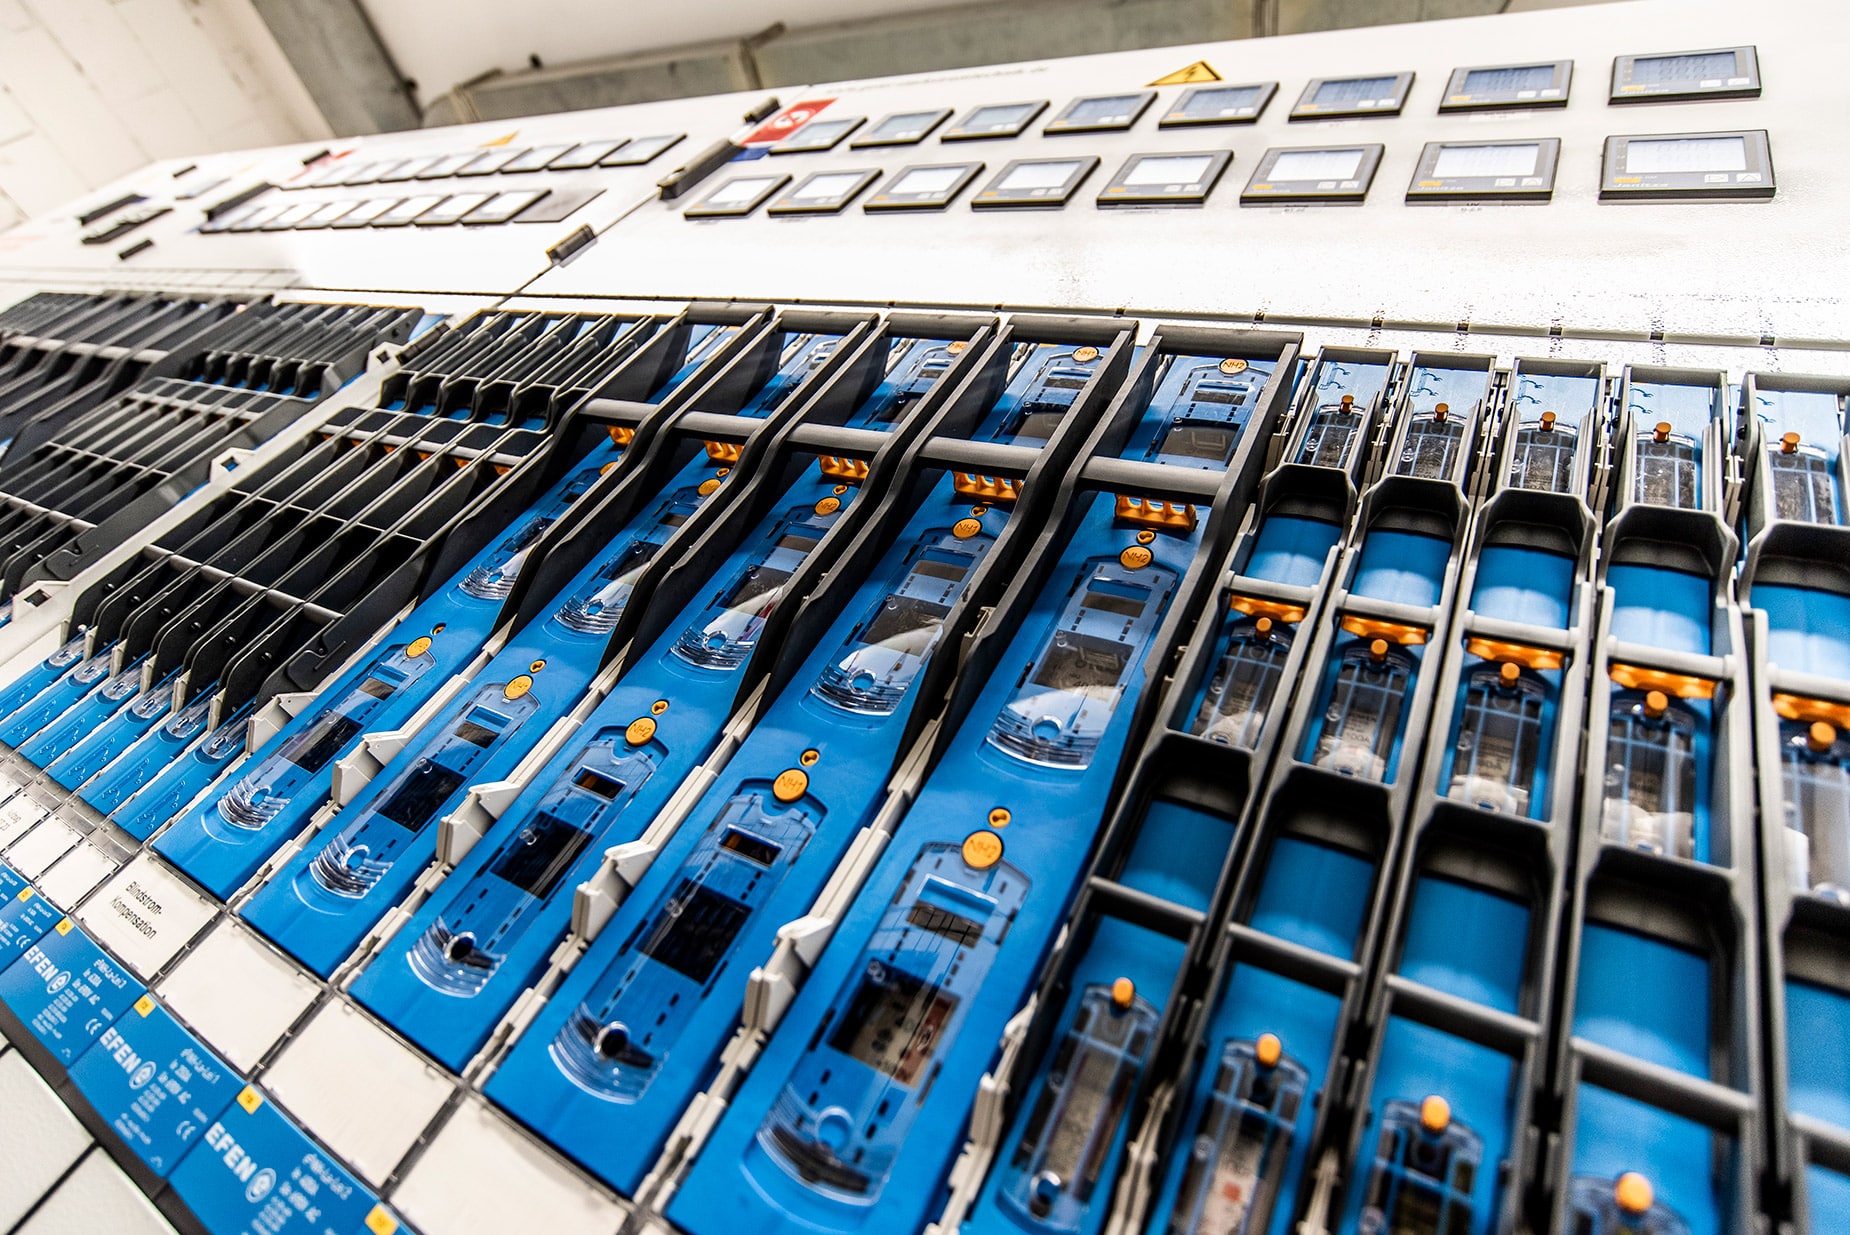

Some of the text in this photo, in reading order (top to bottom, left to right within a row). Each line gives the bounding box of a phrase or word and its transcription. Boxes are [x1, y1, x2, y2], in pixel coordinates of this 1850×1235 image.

[1222, 361, 1245, 369] NH2
[1123, 550, 1149, 563] NH2
[629, 723, 652, 738] NH2
[125, 881, 162, 915] Blindstrom-
[109, 897, 157, 941] Kompensation
[23, 945, 59, 983] EFEN
[99, 1027, 142, 1075] EFEN
[204, 1121, 258, 1183] EFEN
